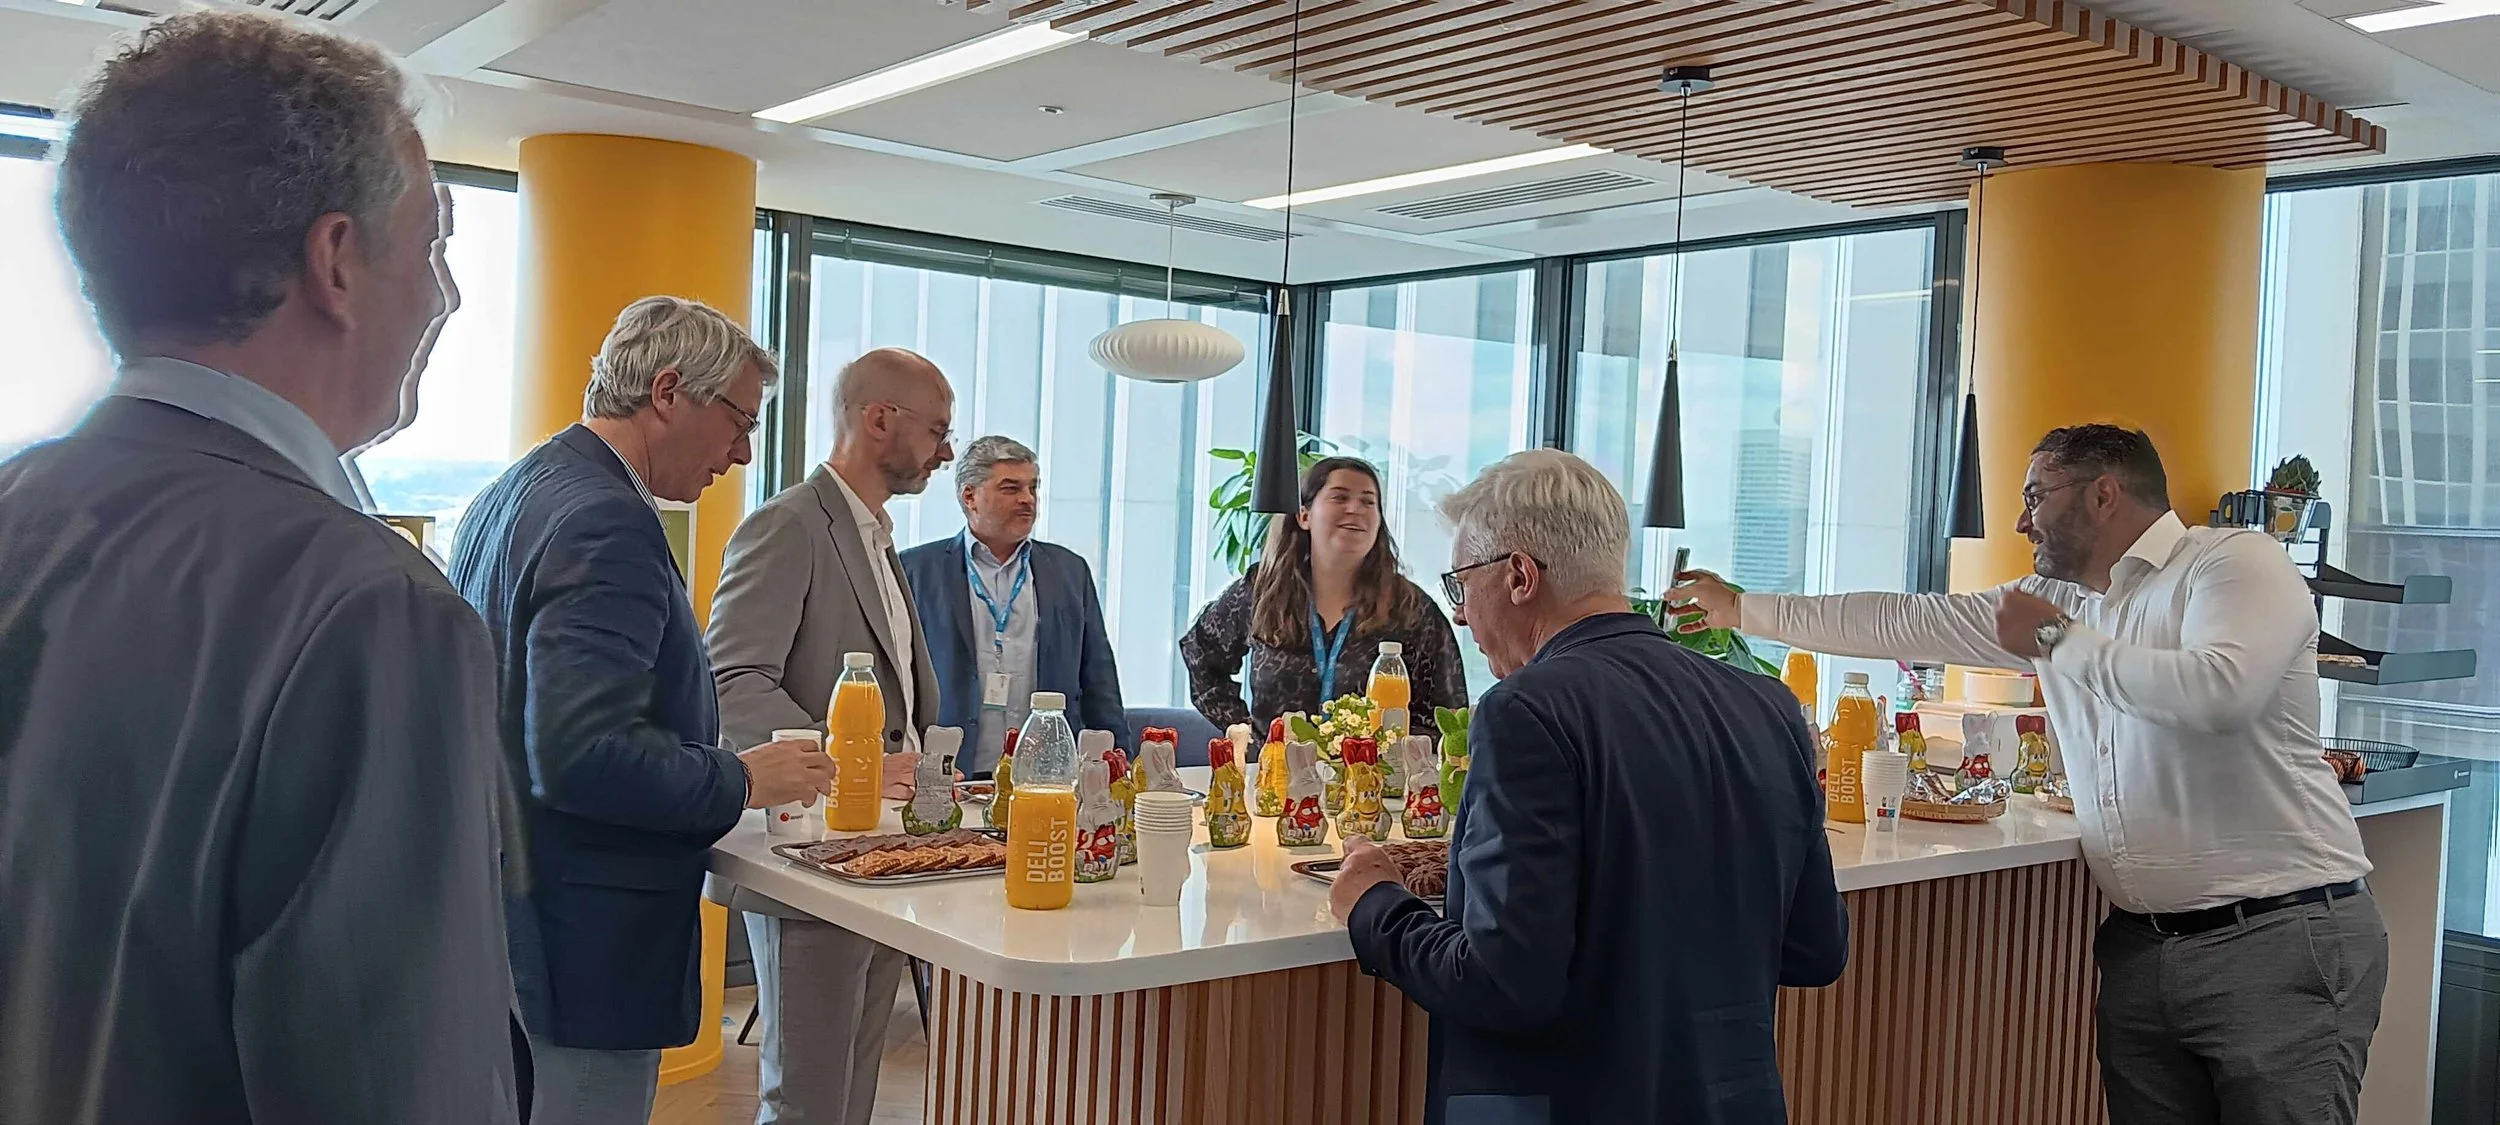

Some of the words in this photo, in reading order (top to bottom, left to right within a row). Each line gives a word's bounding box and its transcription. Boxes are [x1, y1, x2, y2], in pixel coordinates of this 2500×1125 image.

[1828, 773, 1840, 802] DELI
[1840, 758, 1856, 804] BOOST
[1026, 841, 1048, 882] DELI
[1047, 816, 1068, 882] BOOST
